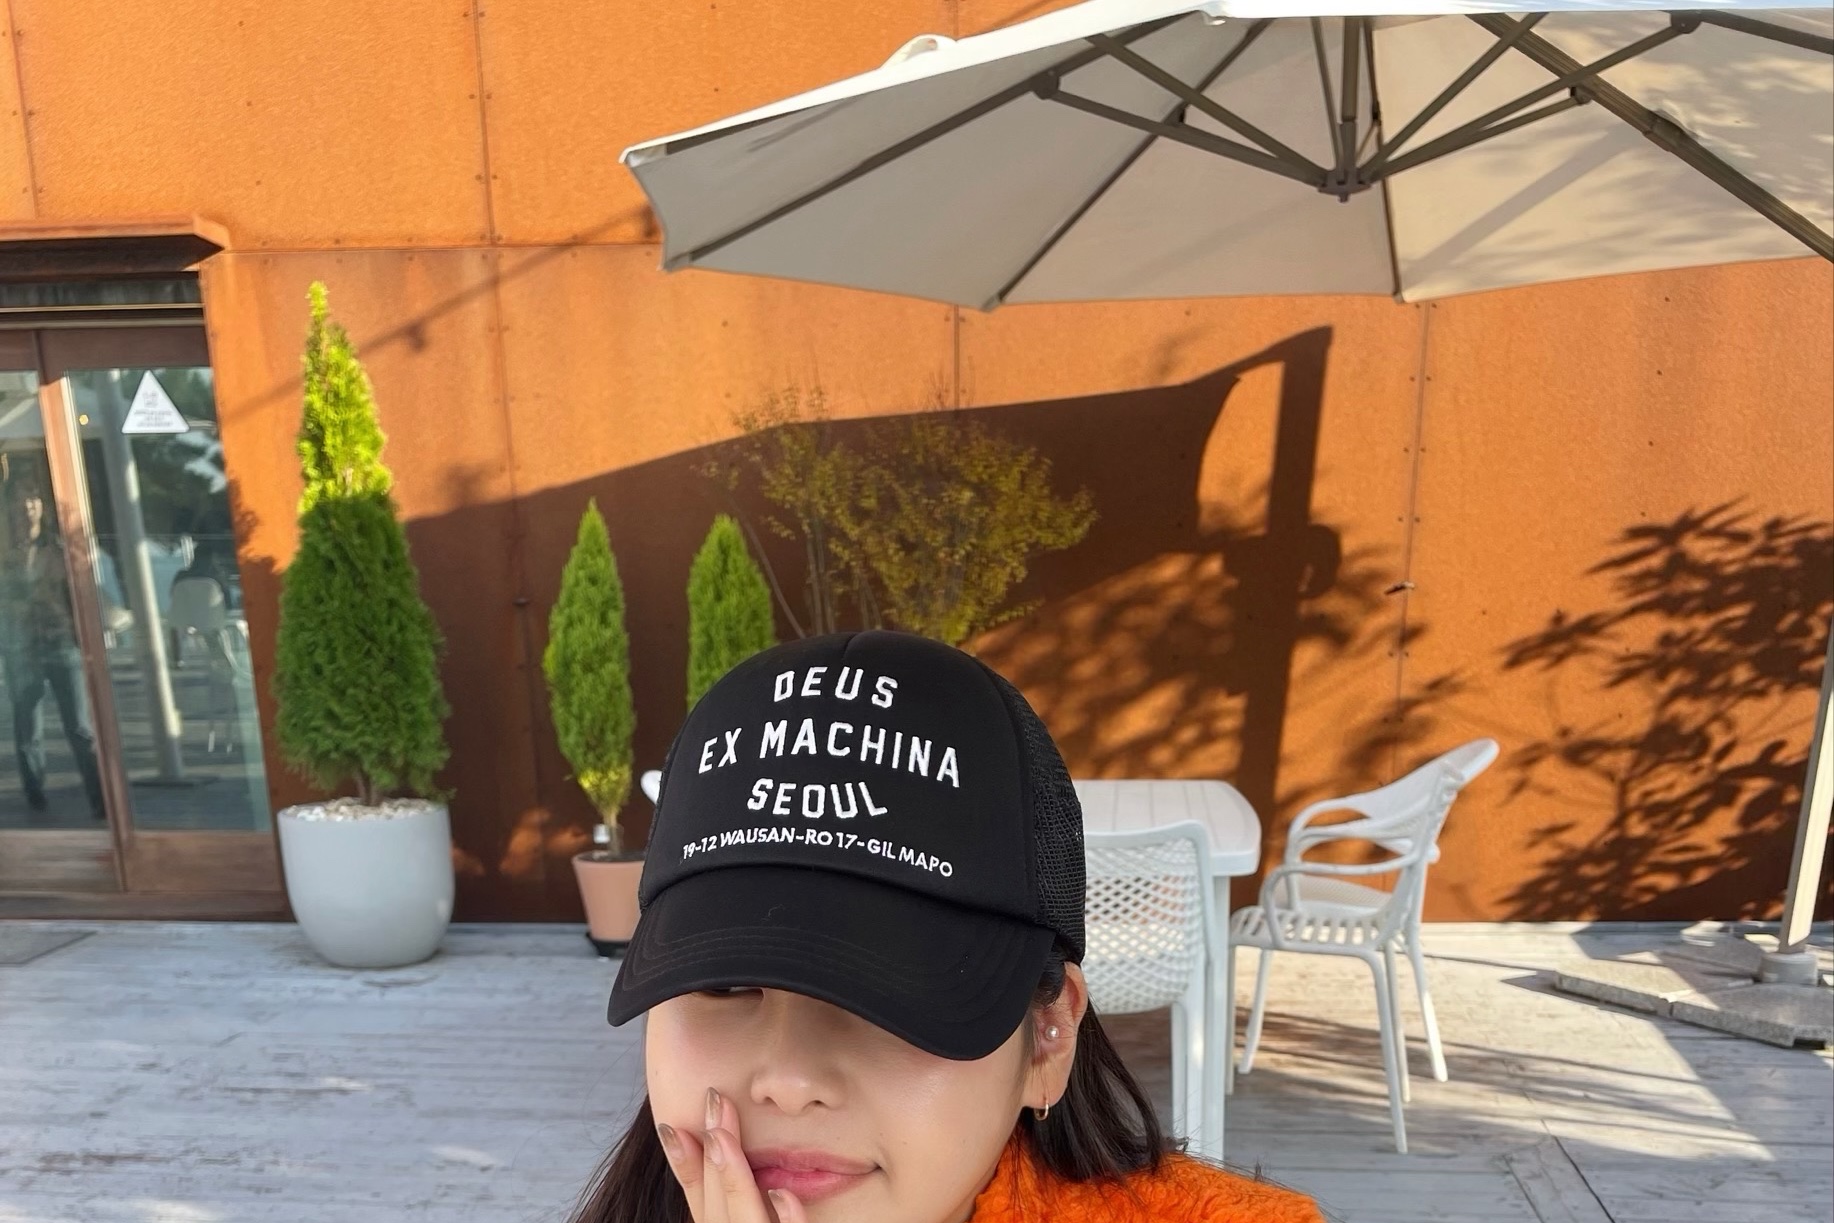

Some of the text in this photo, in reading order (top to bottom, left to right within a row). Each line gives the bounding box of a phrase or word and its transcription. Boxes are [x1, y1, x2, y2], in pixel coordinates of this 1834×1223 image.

[773, 666, 898, 709] DEUS
[698, 717, 960, 788] EX MACHINA
[747, 777, 888, 819] SEOUL
[682, 826, 953, 878] 19-12 WAUSAN-RO 17-GIL MAPO
